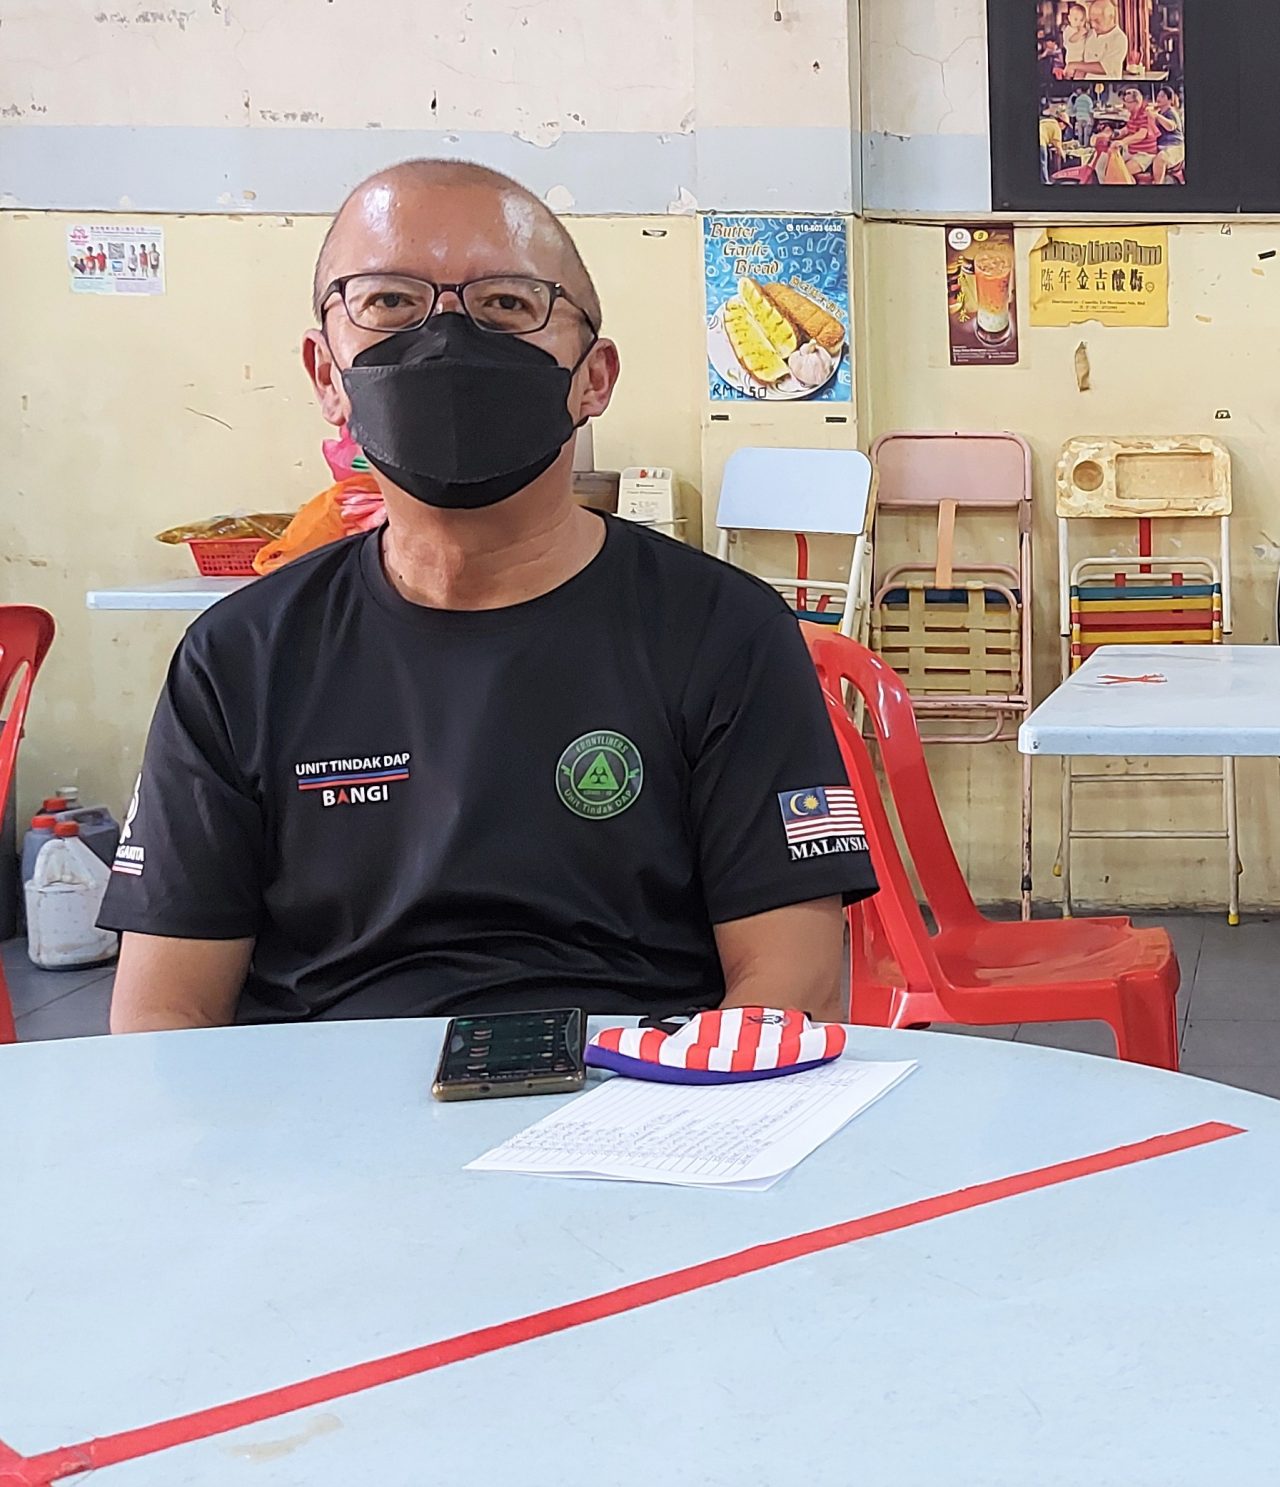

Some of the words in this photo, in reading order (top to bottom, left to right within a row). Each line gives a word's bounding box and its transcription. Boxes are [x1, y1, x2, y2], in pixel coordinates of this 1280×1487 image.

[711, 222, 757, 238] Butter
[723, 240, 769, 256] Garlic
[1041, 236, 1087, 267] Honey
[1087, 240, 1122, 265] Lime
[1122, 239, 1162, 266] Plum
[735, 259, 779, 274] Bread
[712, 383, 733, 397] RM
[295, 762, 328, 775] UNIT
[329, 757, 382, 772] TINDAK
[383, 753, 410, 767] DAP
[322, 784, 388, 807] BANGI
[564, 789, 580, 807] Unit
[582, 803, 614, 815] Tindak
[614, 790, 632, 808] DAP
[788, 837, 869, 860] MALAYSIA
